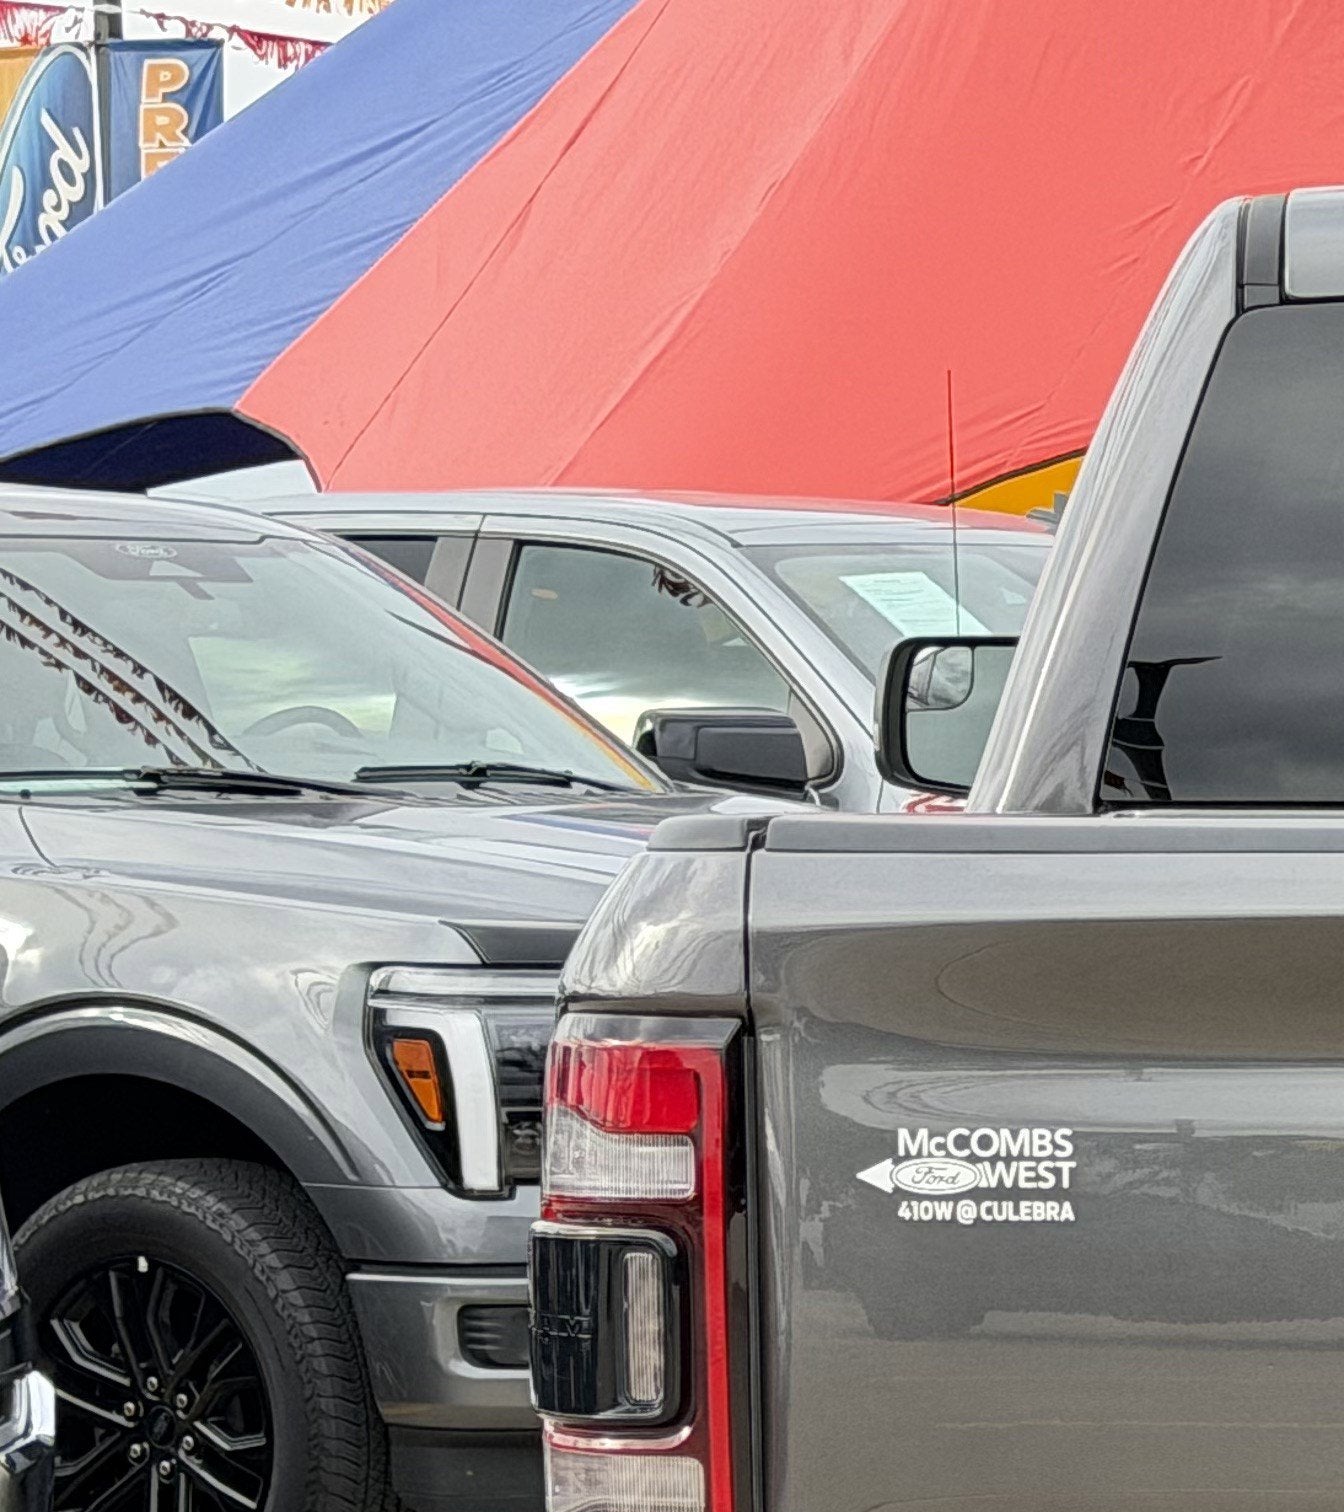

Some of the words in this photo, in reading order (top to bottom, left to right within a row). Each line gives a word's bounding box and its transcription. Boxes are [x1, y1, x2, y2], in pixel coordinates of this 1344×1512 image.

[897, 1127, 1074, 1158] McCOMBS
[911, 1166, 960, 1186] Ford
[982, 1160, 1077, 1190] WEST
